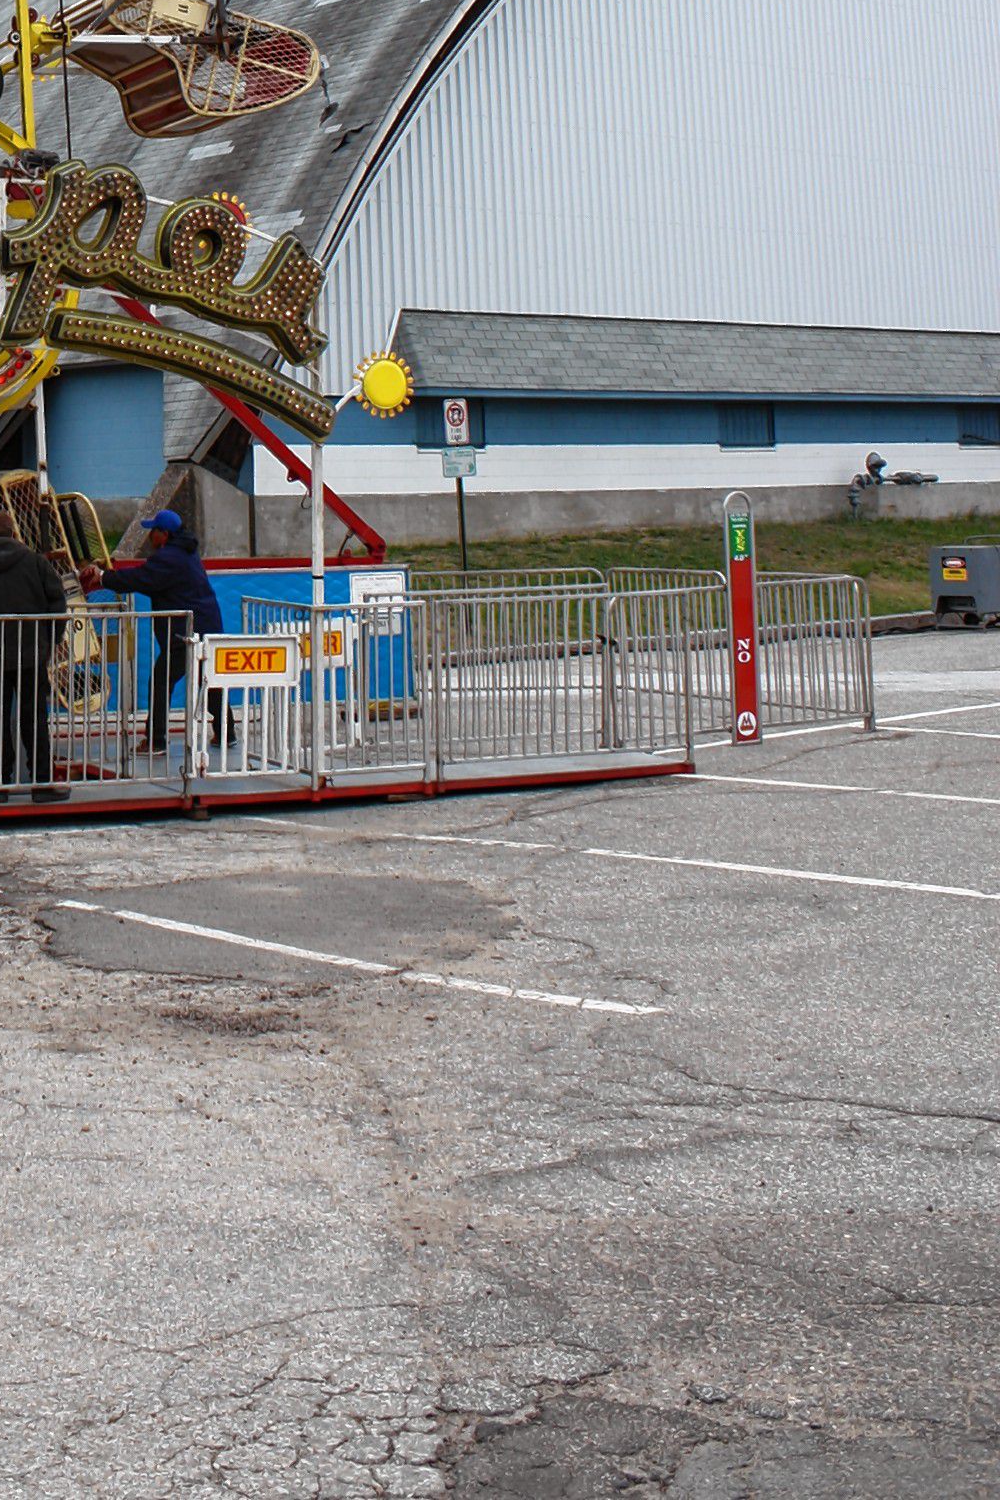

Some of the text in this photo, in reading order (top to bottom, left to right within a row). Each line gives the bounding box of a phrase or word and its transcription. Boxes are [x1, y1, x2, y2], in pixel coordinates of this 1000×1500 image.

[734, 529, 746, 552] YES
[224, 650, 278, 671] EXIT
[737, 638, 752, 663] NO
